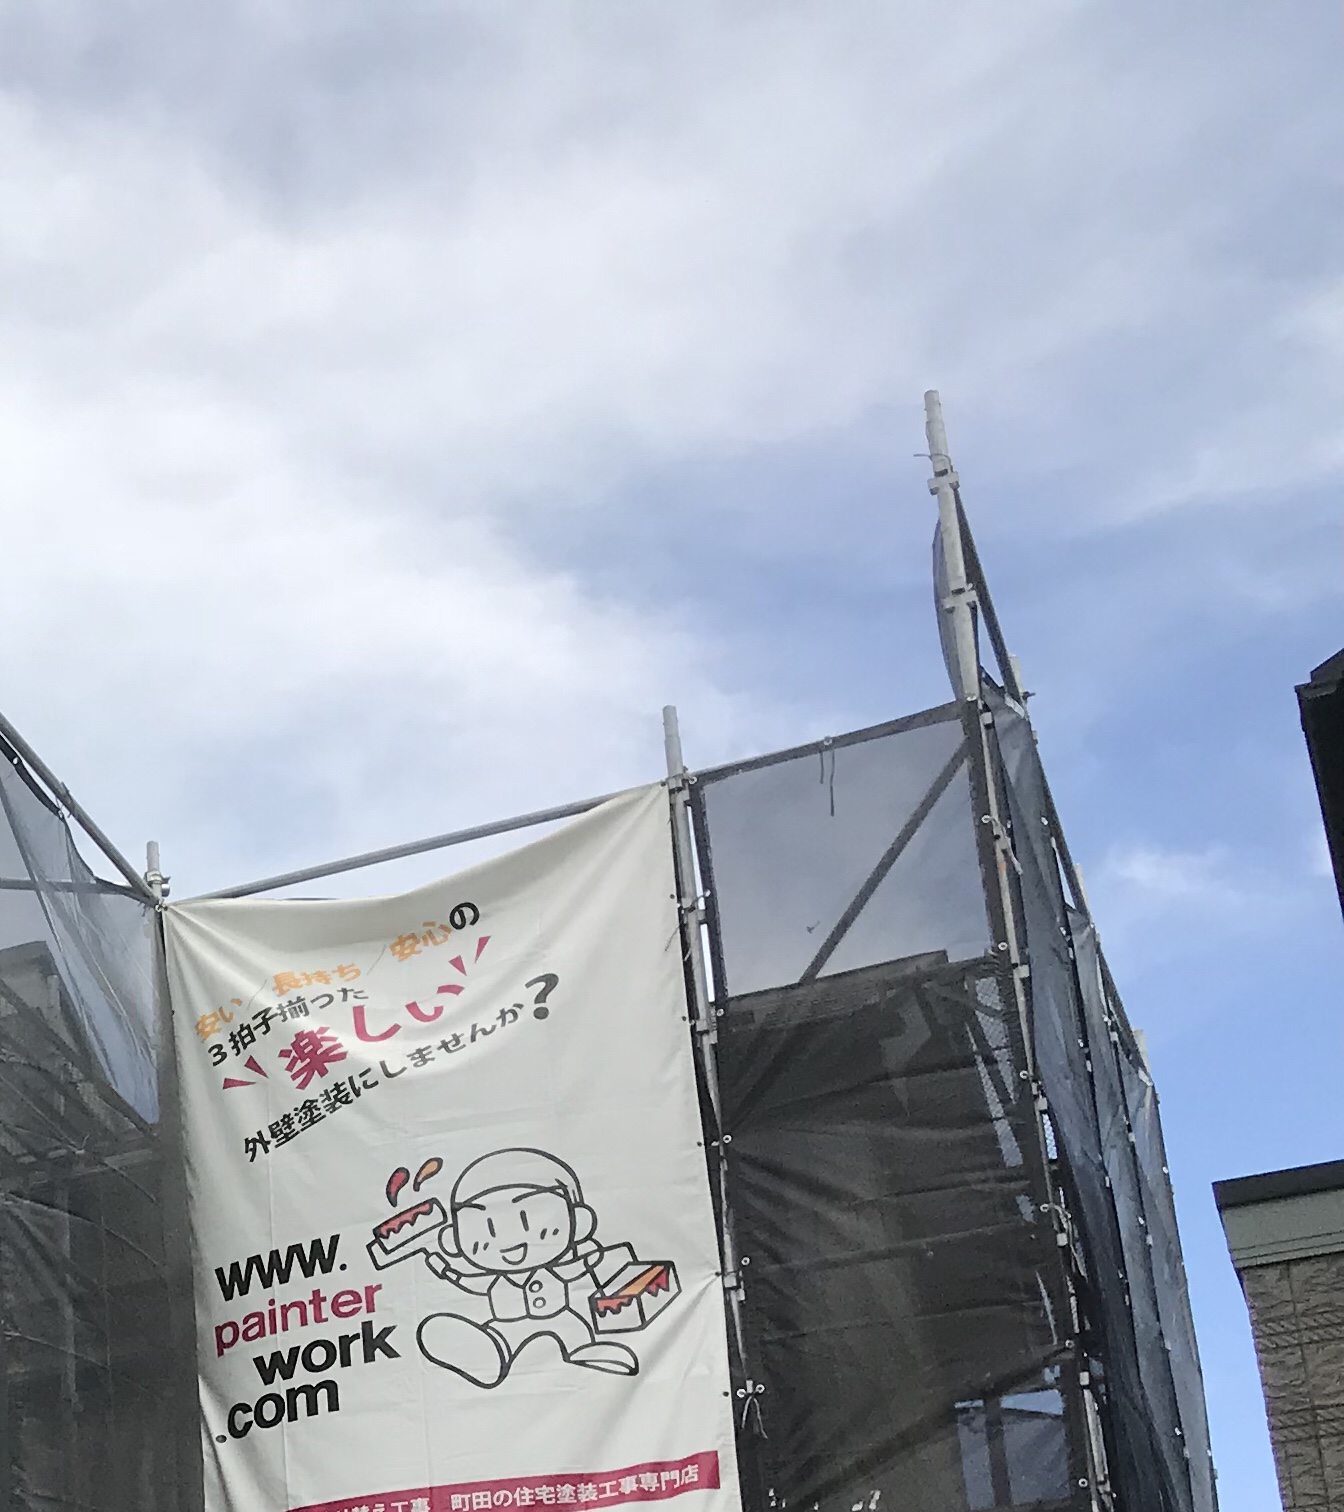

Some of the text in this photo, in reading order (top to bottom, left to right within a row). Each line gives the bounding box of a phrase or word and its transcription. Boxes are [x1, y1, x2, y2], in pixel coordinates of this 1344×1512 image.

[277, 983, 465, 1090] 楽しい
[214, 1233, 347, 1302] www.
[214, 1284, 382, 1357] painter
[253, 1320, 401, 1386] work
[215, 1379, 340, 1443] .com
